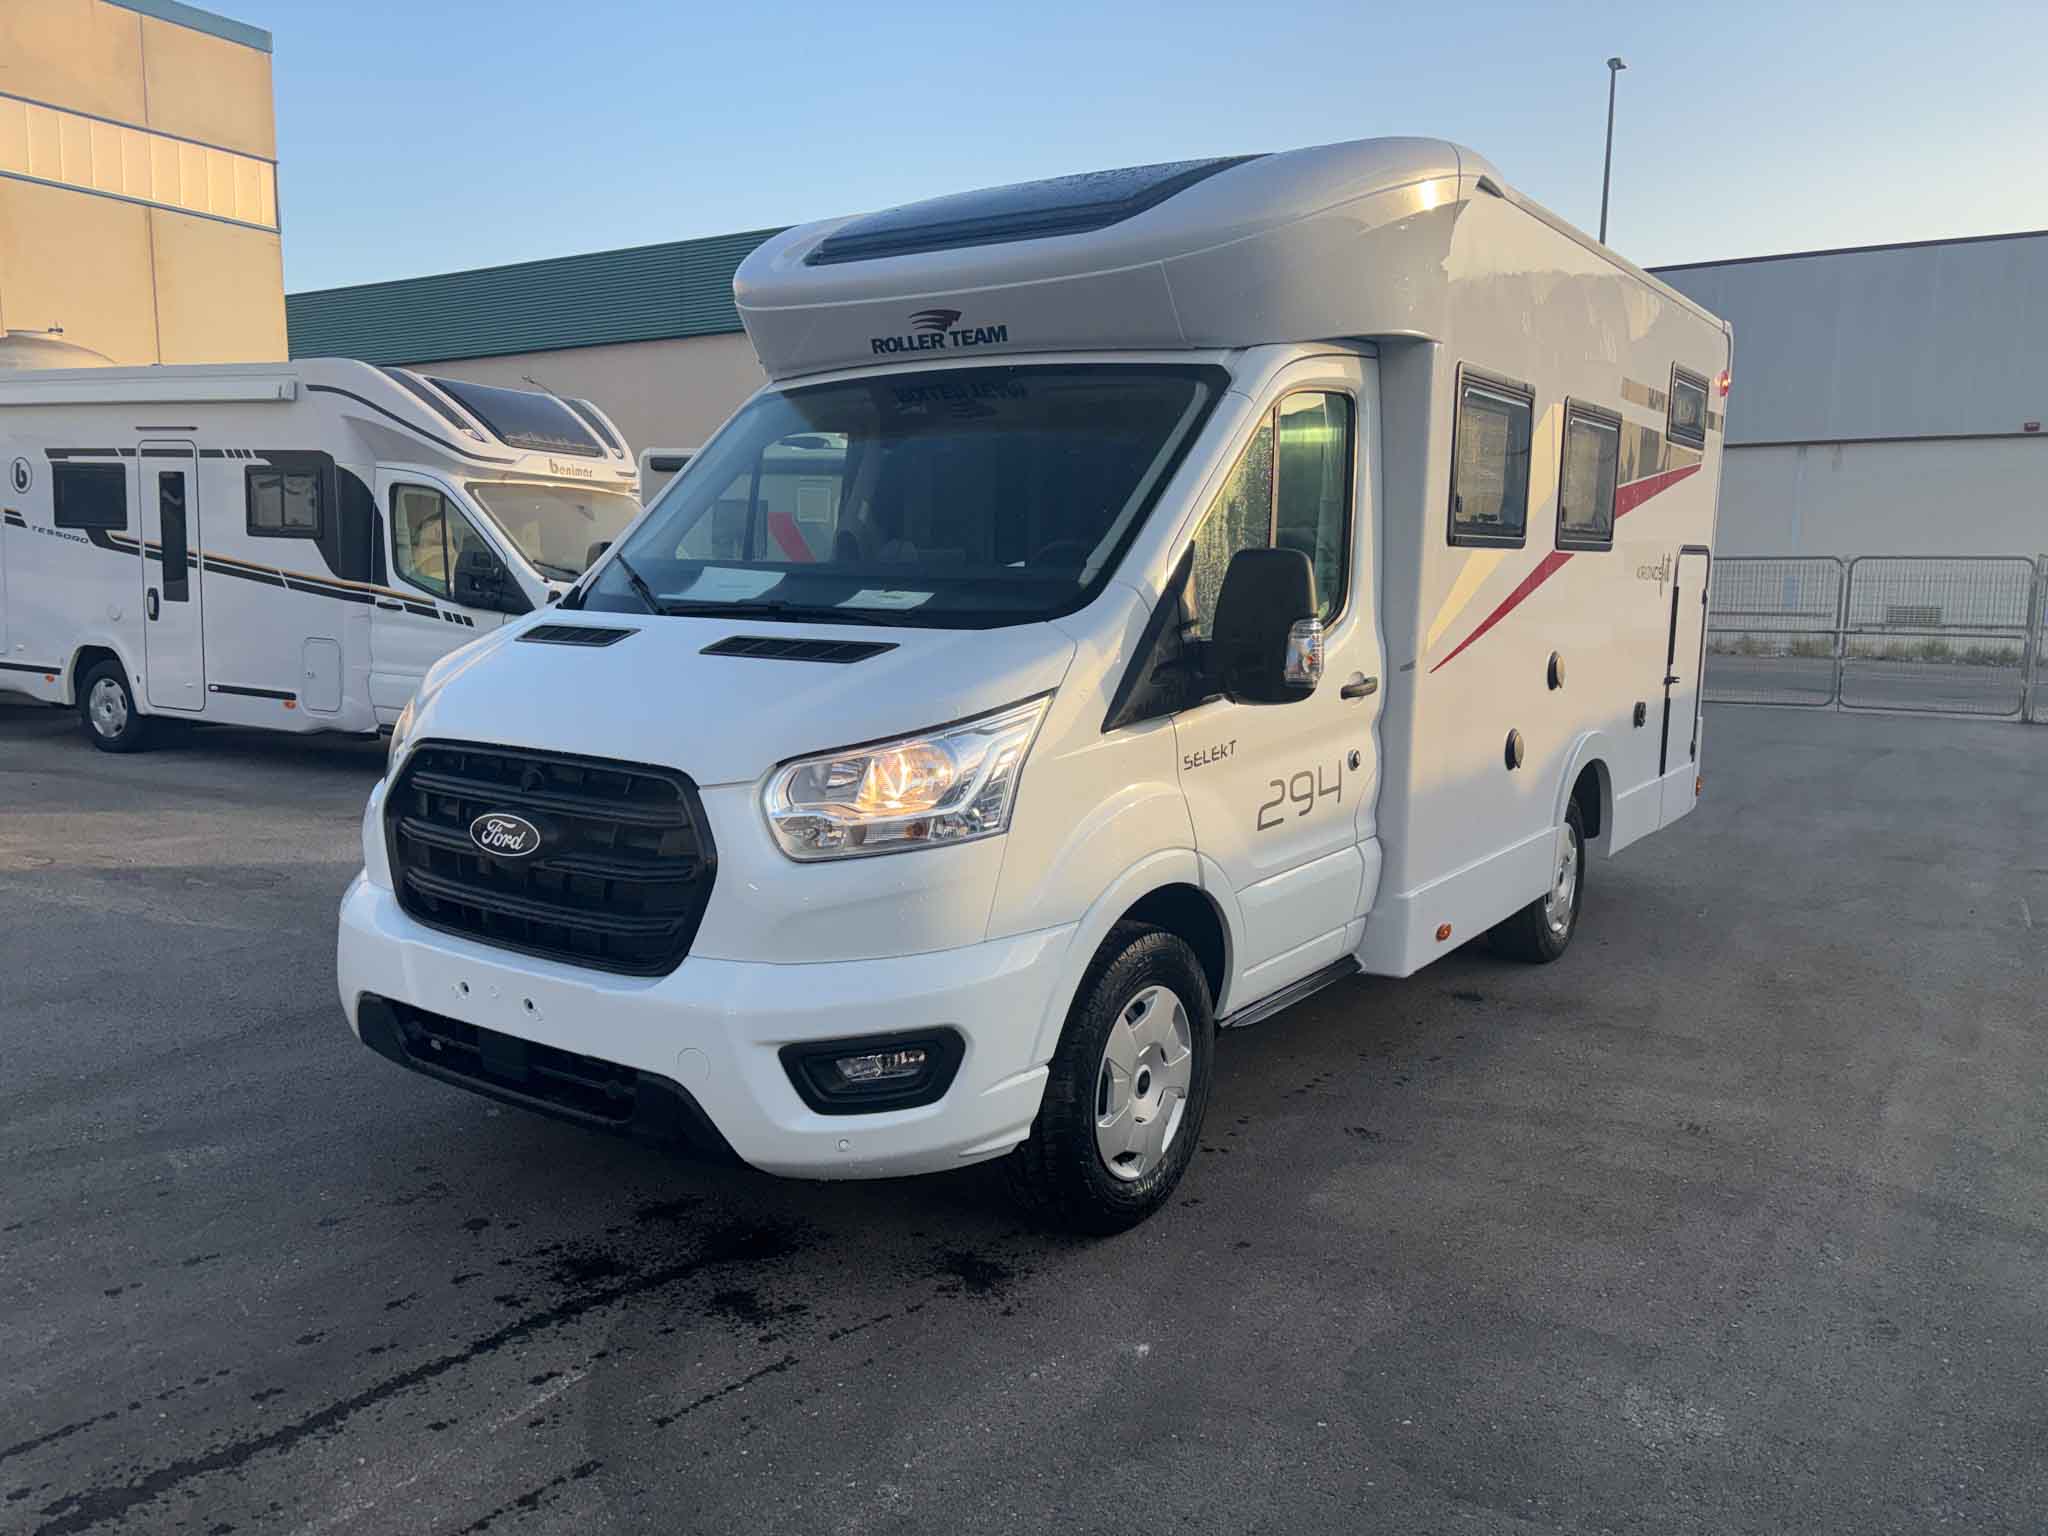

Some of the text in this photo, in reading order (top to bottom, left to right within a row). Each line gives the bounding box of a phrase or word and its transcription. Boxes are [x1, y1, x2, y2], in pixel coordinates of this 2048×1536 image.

[871, 325, 1008, 354] ROLLER TEAM
[1183, 739, 1237, 771] SELEKT
[1257, 759, 1342, 831] 294
[481, 818, 527, 851] Ford
